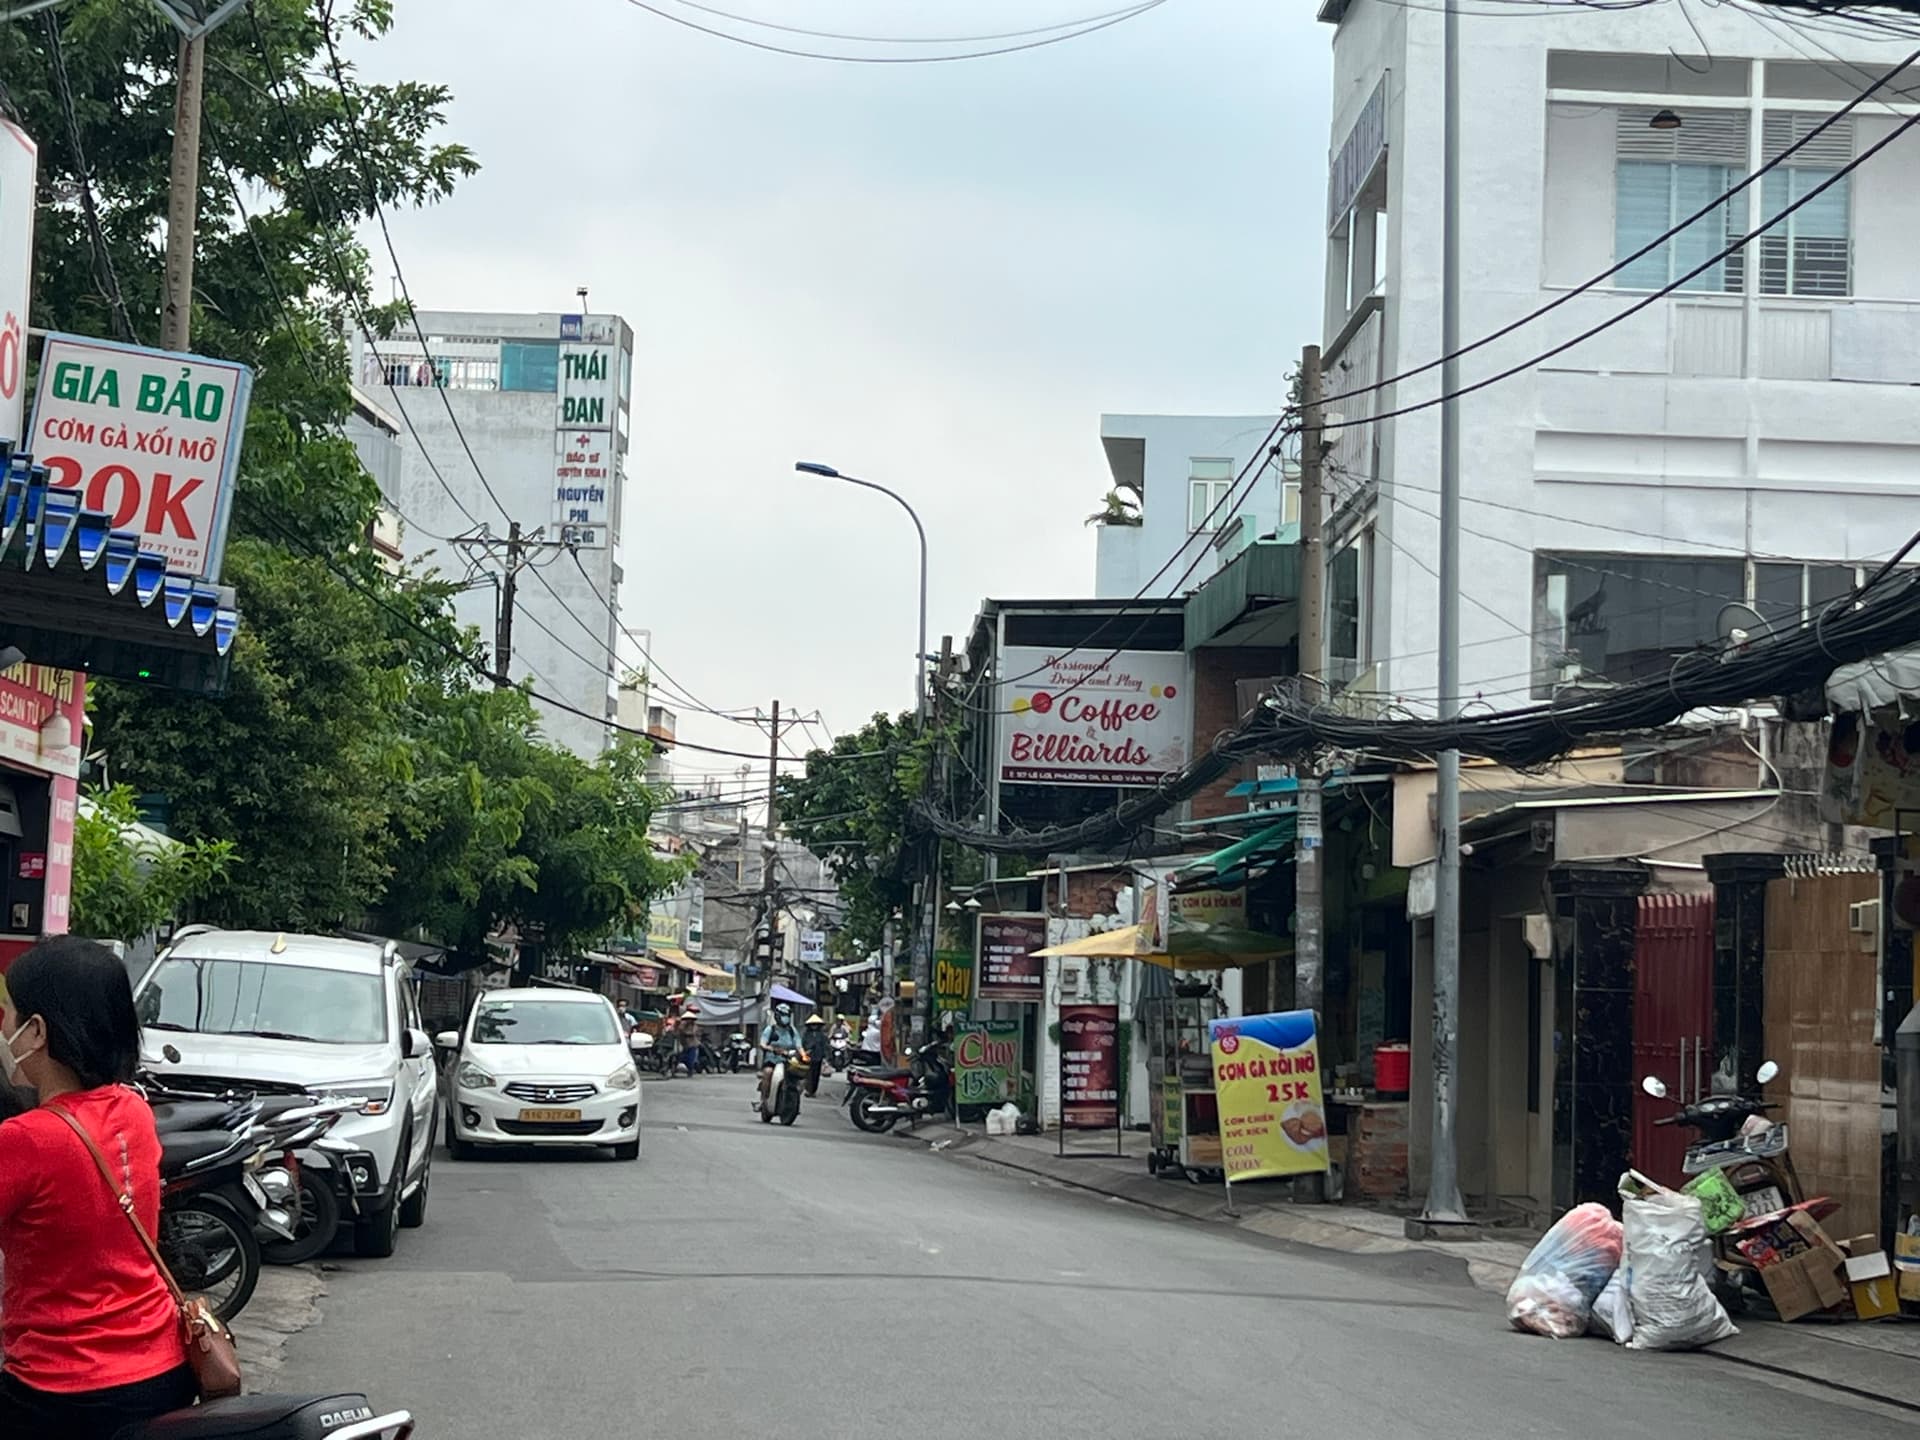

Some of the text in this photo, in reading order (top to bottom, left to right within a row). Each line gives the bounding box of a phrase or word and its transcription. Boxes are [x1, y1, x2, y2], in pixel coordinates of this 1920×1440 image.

[563, 350, 607, 380] THÁI
[52, 361, 224, 423] GIA BẢO
[43, 418, 216, 462] CƠM GÀ XỐI MỠ
[569, 509, 589, 522] PHI
[1059, 696, 1160, 731] Coffee
[1011, 733, 1150, 765] Billiards
[937, 960, 971, 1000] Chay
[959, 1029, 1017, 1077] Chay
[1266, 1080, 1309, 1103] 25K
